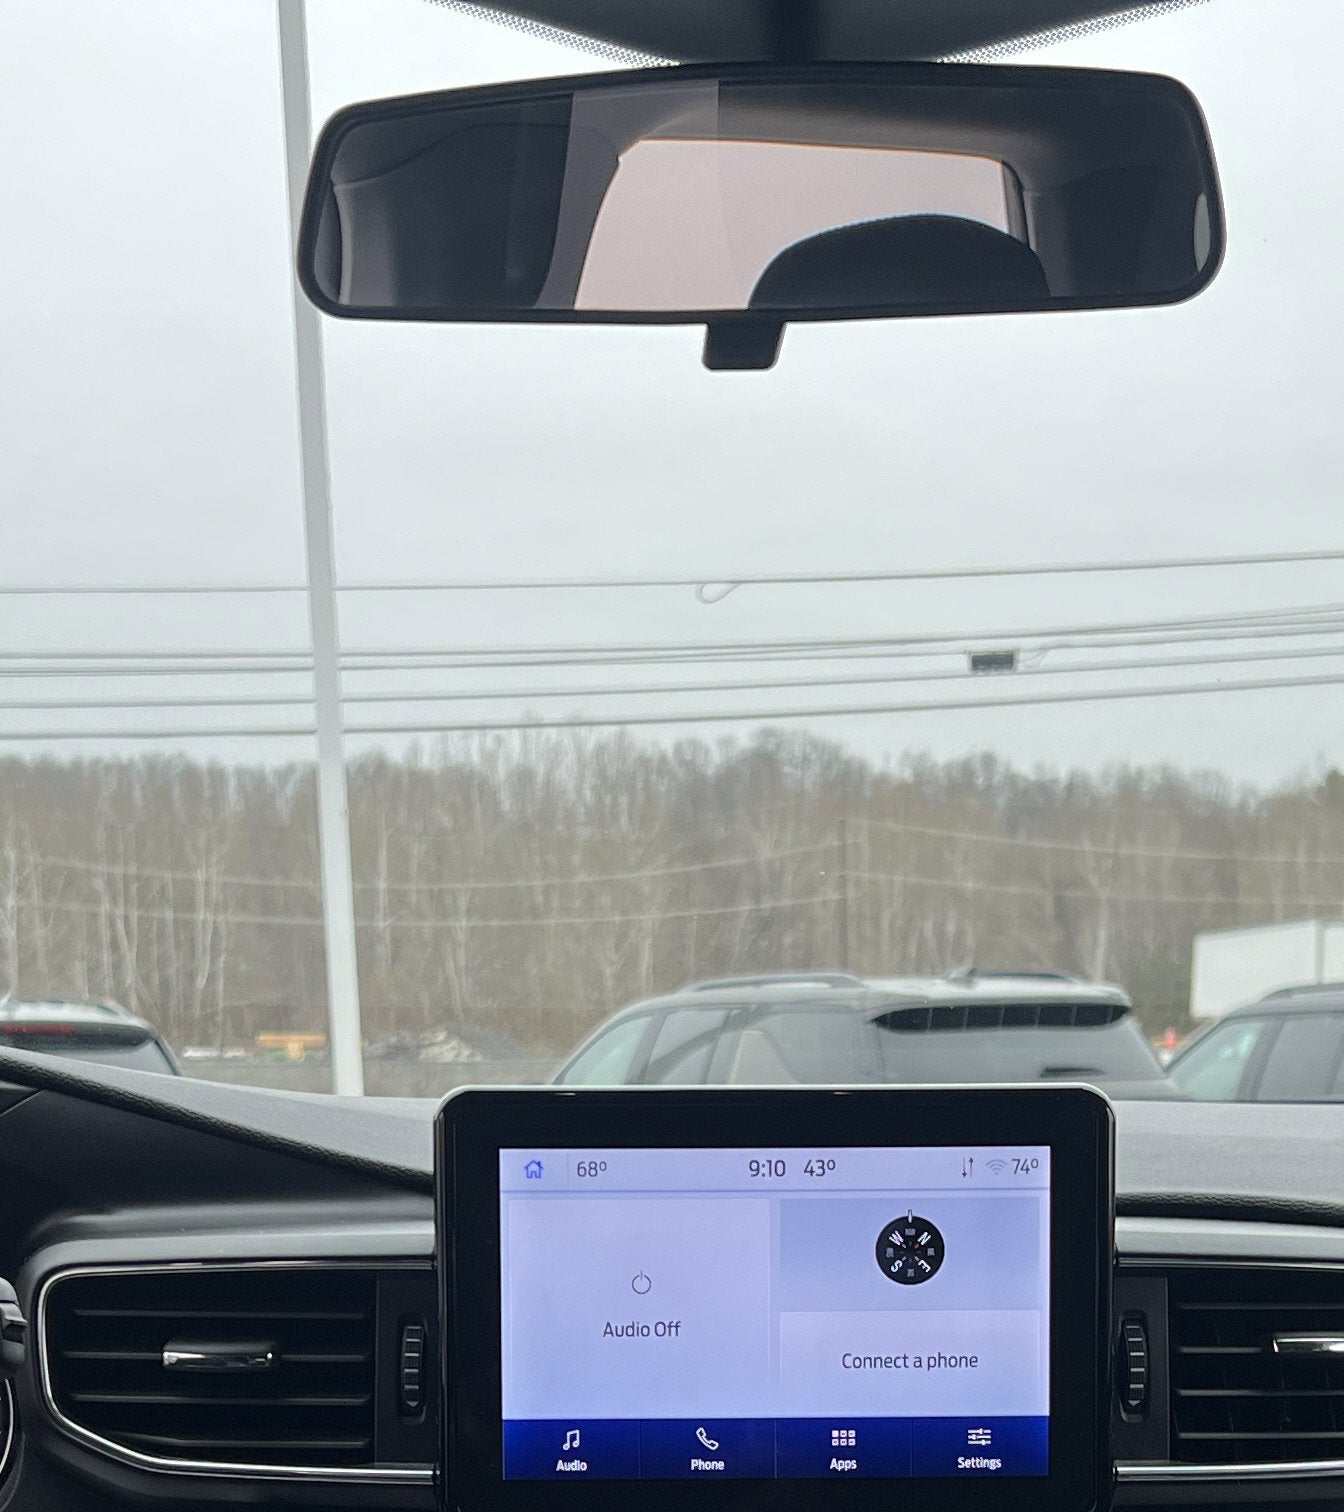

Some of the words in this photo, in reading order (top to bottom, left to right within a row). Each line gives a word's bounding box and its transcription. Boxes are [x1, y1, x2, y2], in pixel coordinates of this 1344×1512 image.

[748, 1158, 787, 1179] 9:10
[602, 1320, 651, 1339] Audio
[654, 1319, 682, 1339] Off
[841, 1352, 909, 1371] Connect
[913, 1357, 923, 1370] a
[926, 1351, 980, 1374] phone
[556, 1457, 588, 1472] Audio
[690, 1456, 725, 1472] Phone
[829, 1456, 858, 1475] Apps
[957, 1455, 1003, 1473] Settings
